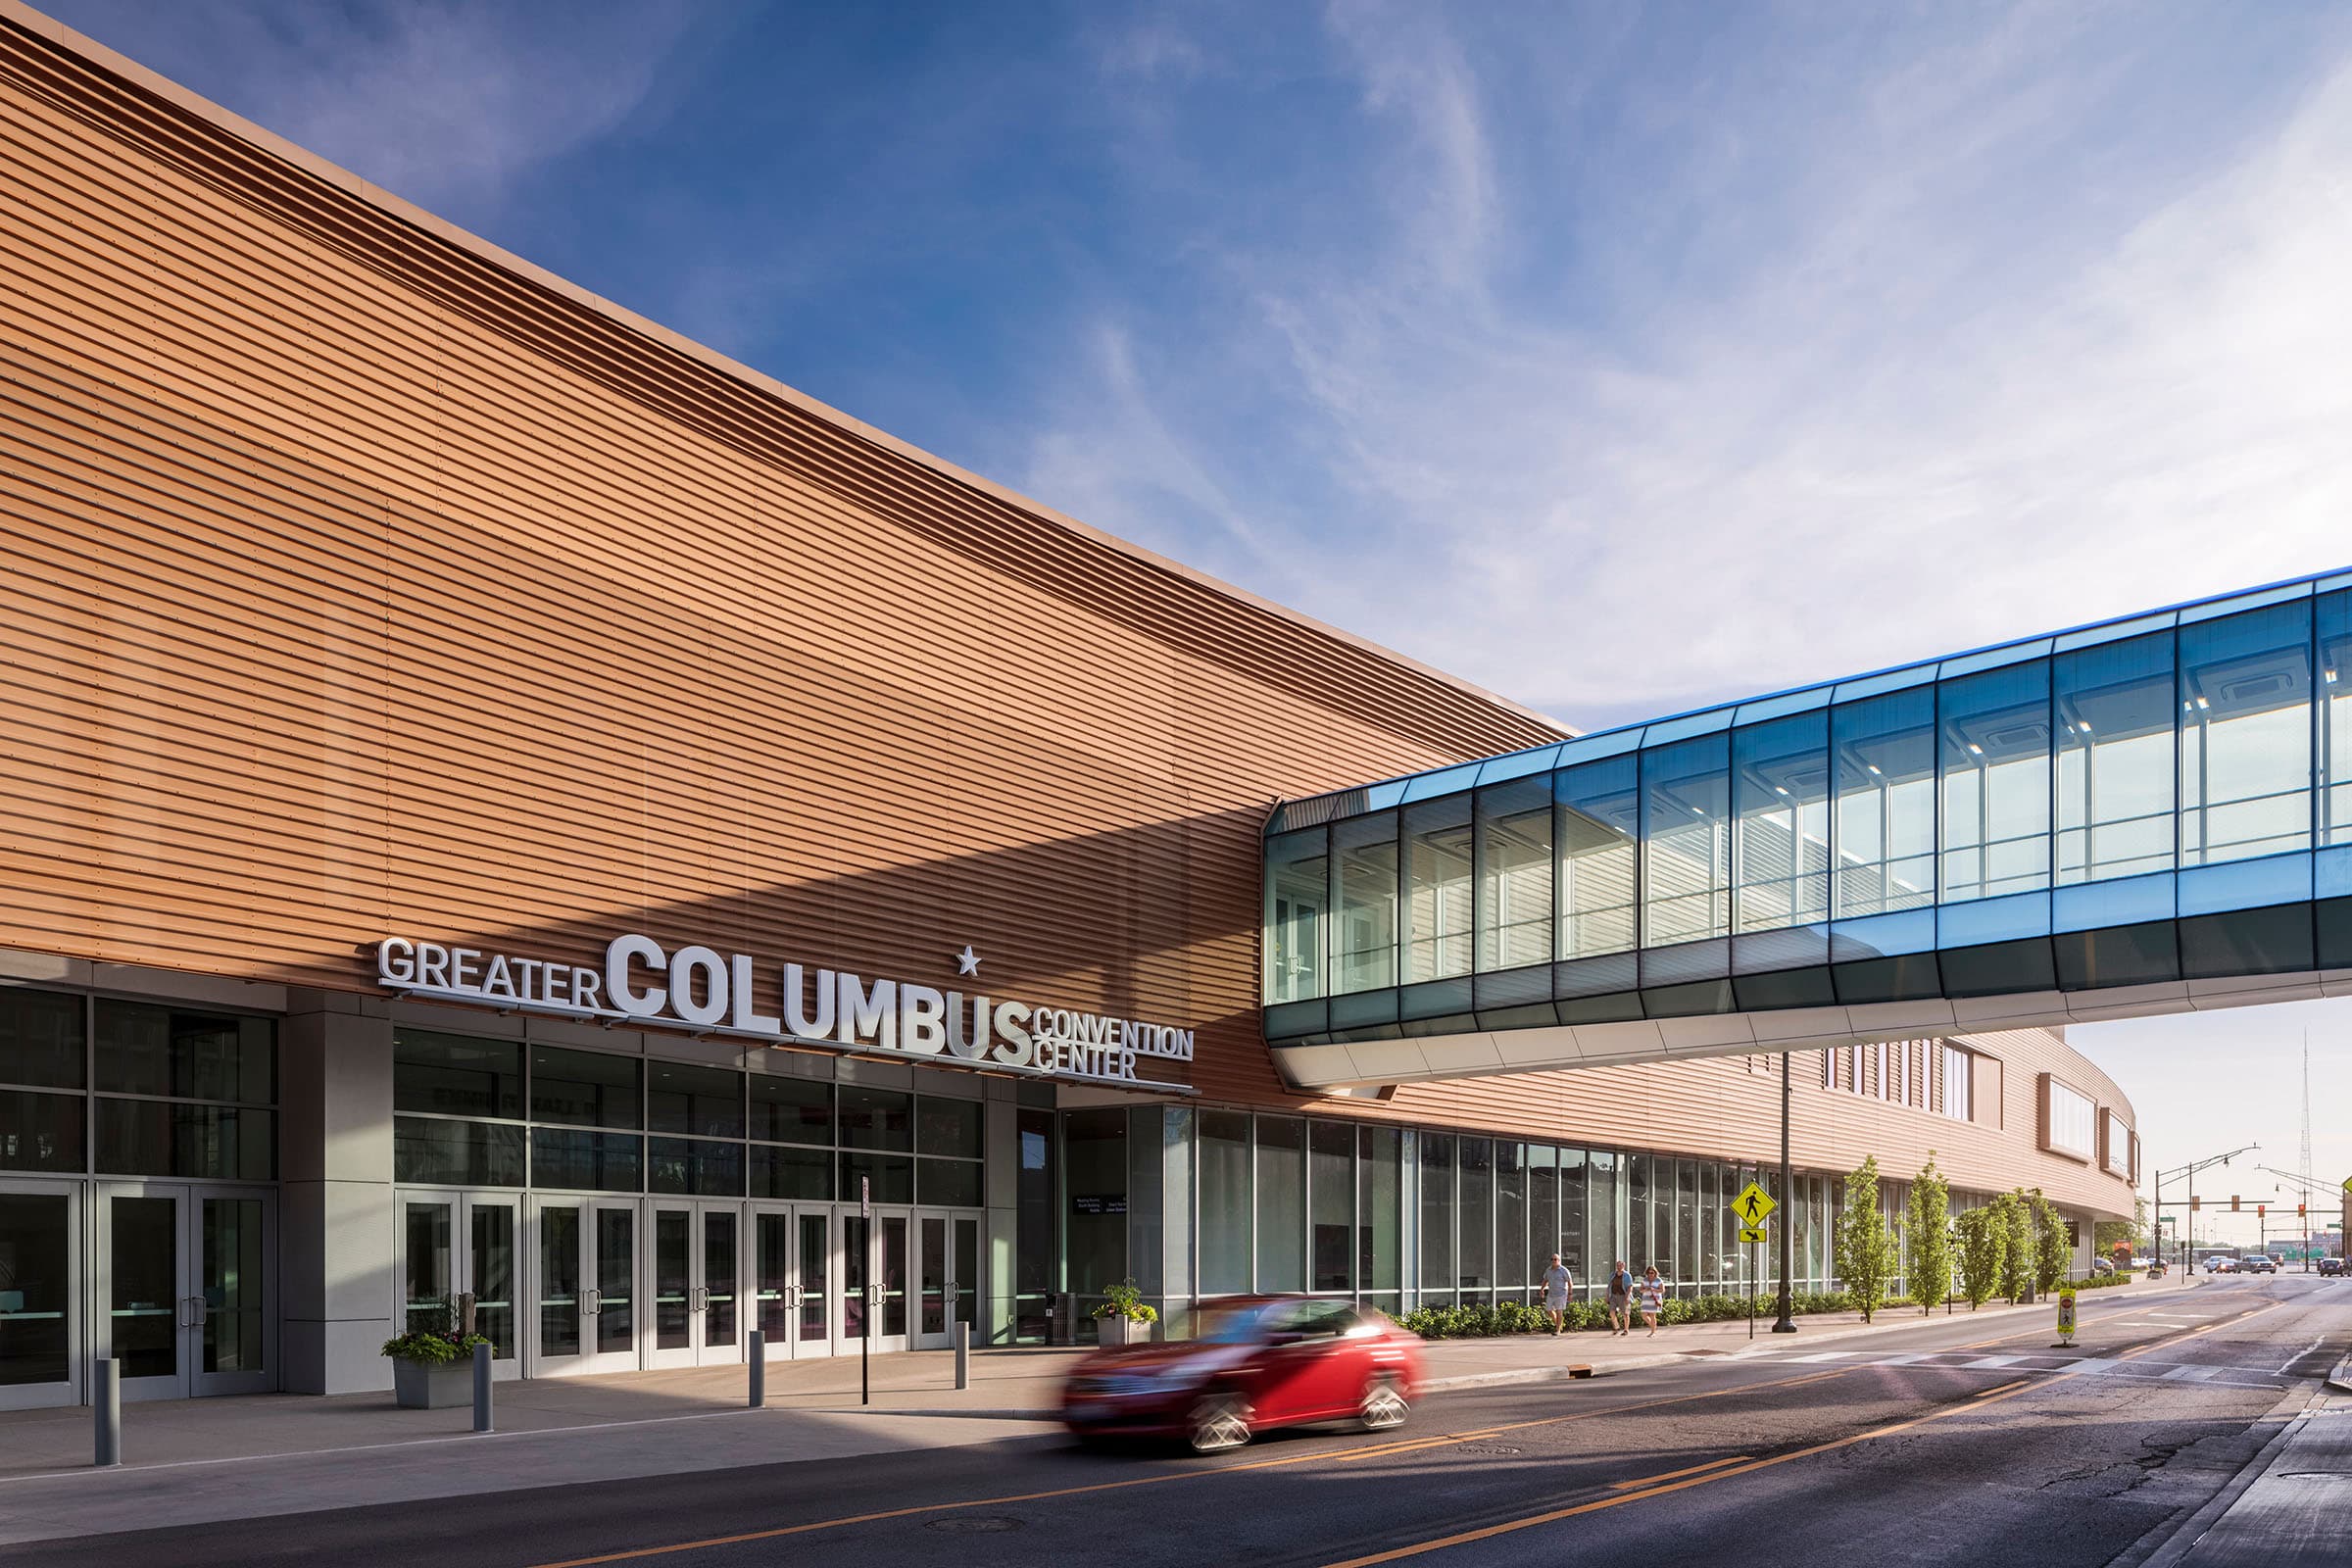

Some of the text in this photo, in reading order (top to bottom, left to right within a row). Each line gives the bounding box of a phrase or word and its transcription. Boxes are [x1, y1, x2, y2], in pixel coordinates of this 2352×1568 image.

[378, 934, 1033, 1066] GREATER COLUMBUS
[1033, 1006, 1195, 1057] CONVENTION
[1034, 1039, 1137, 1080] CENTER
